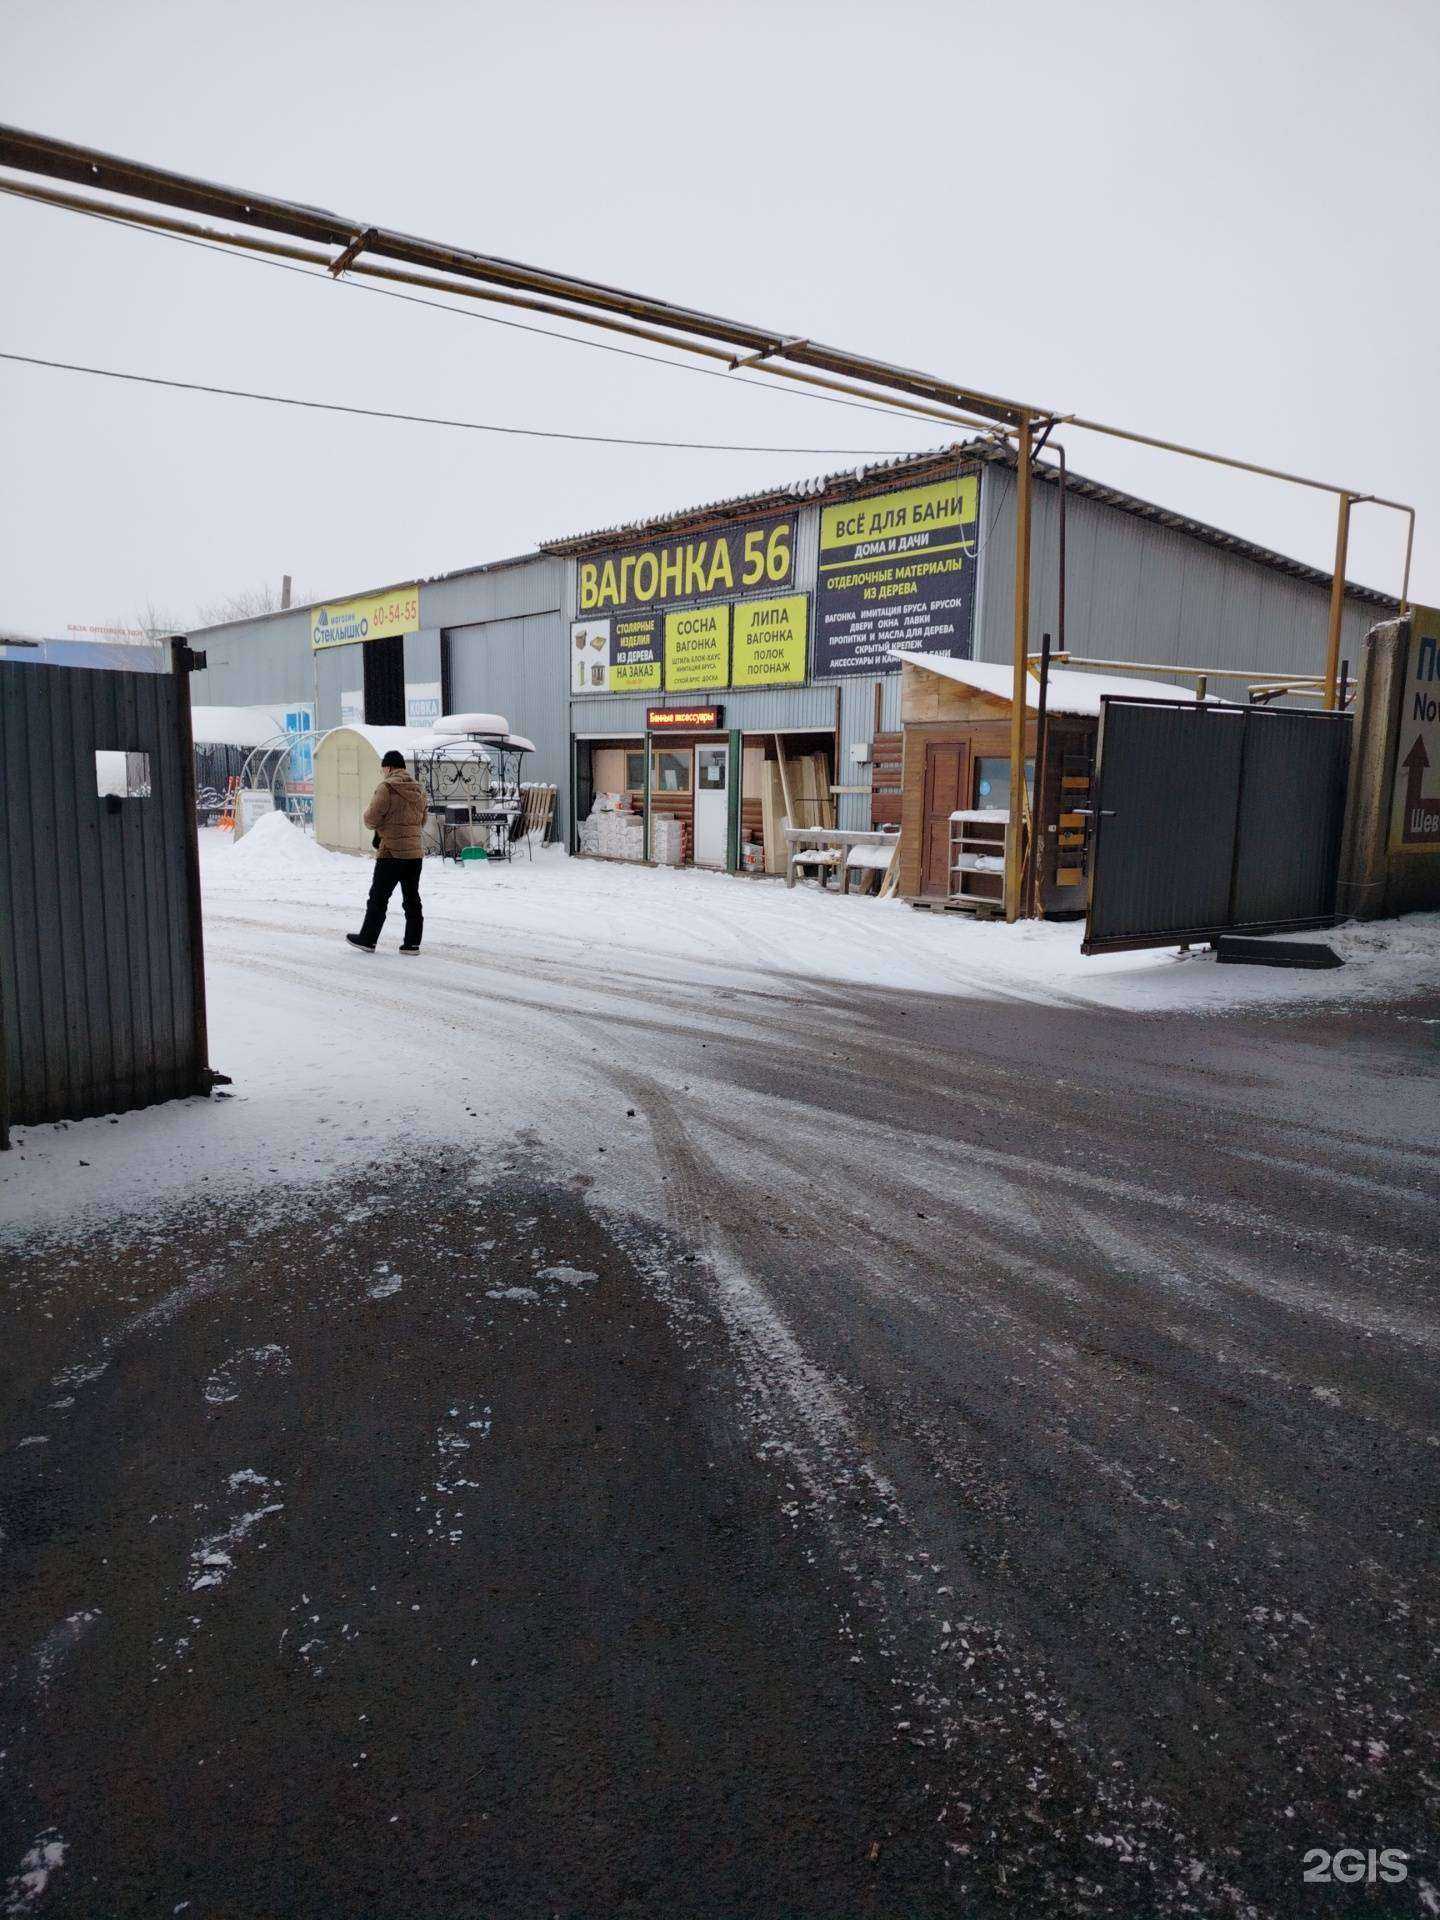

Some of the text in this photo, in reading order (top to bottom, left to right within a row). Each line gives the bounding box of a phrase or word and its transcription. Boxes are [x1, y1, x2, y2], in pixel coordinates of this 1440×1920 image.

[836, 496, 963, 538] ВСЁ ДЛЯ БАНИ
[854, 532, 929, 559] ДОМА И ДАЧИ
[580, 525, 790, 609] ВАГОНКА 56
[827, 558, 962, 589] ОТДЕЛОЧНЫЕ МАТЕРИАЛЫ
[864, 581, 917, 600] ИЗ ДЕРЕВА
[373, 600, 417, 626] 60-54-55
[751, 608, 789, 627] ЛИПА
[825, 598, 962, 623] ВАГОНКА ИМИТАЦИЯ БРУСА БРУСОК
[616, 620, 655, 634] СТОЛЯРНЫЕ
[677, 617, 716, 635] СОСНА
[850, 614, 931, 633] ДВЕРИ ОКНА ЛАВКИ
[620, 634, 651, 648] ИЗДЕЛИЯ
[746, 629, 793, 645] ВАГОНКА
[829, 624, 954, 645] ПРОПИТКИ И МАСЛА ДЛЯ ДЕРЕВА
[676, 638, 717, 653] ВАГОНКА
[753, 648, 784, 660] ПОЛОК
[855, 639, 922, 654] СКРЫТЫЙ КРЕПЕЖ
[617, 649, 654, 664] ИЗ ДЕРЕВА
[830, 655, 873, 668] АКСЕССУАРЫ
[875, 655, 881, 664] И
[617, 664, 654, 678] НА ЗАКАЗ
[747, 661, 791, 675] ПОГОНАЖ
